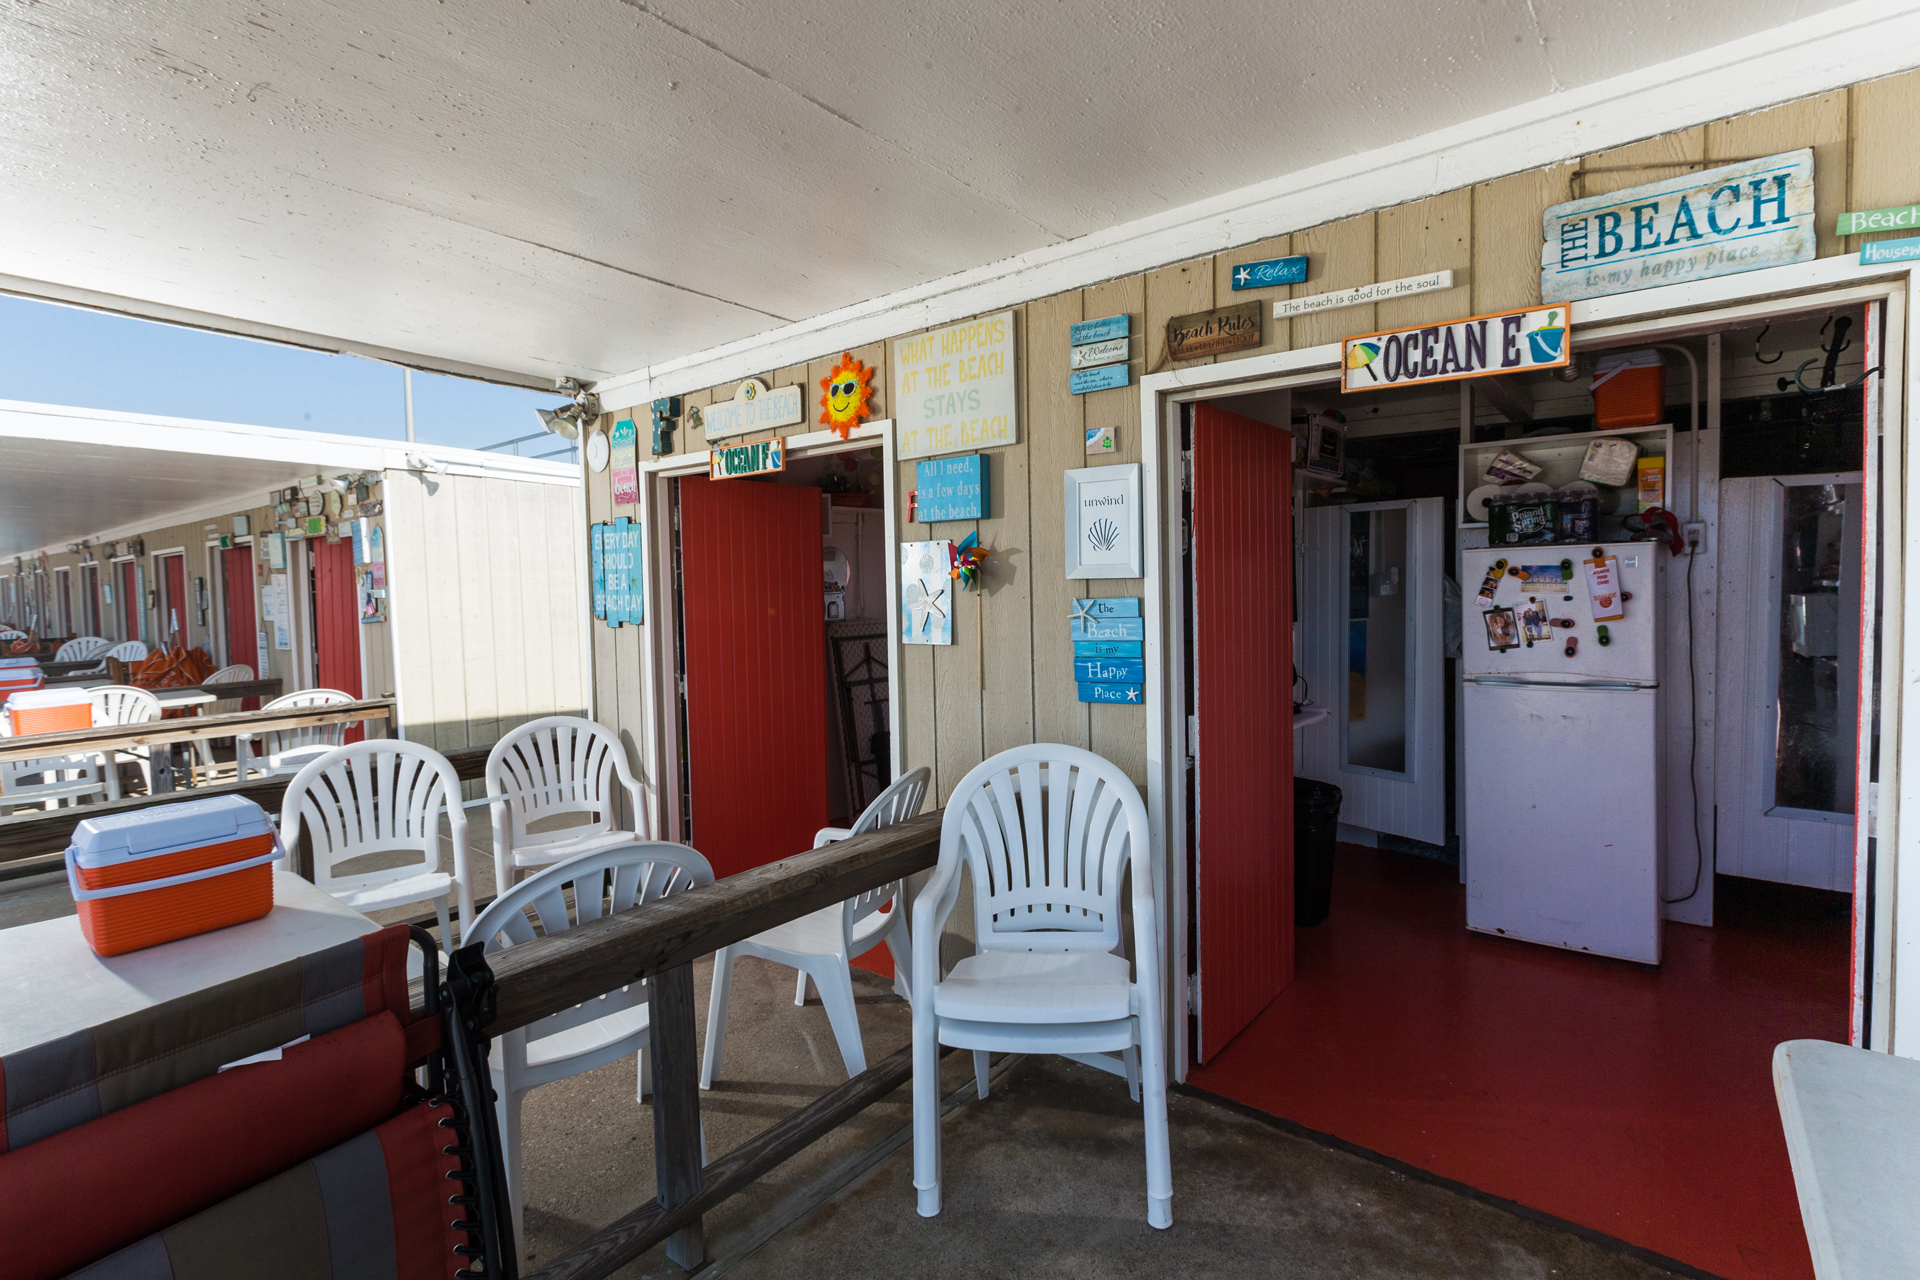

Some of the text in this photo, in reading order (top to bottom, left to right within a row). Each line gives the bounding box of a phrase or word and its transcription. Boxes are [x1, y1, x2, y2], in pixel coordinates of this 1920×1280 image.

[1593, 173, 1792, 259] BEACH
[1560, 217, 1588, 269] THE
[1254, 262, 1300, 281] Relax
[1585, 245, 1760, 287] is my happy place
[1282, 275, 1440, 314] The beach is good for the soul
[1173, 314, 1255, 347] Beach Rules
[899, 319, 1005, 367] WHAT HAPPENS
[1088, 344, 1124, 357] Welcome
[1383, 315, 1522, 382] OCEAN E
[902, 350, 1004, 395] AT THE BEACH
[706, 392, 798, 433] WELCOME TO THE BEACH
[923, 388, 981, 419] STAYS
[902, 414, 1007, 454] AT THE BEACH
[724, 444, 760, 475] OCEAN
[923, 462, 938, 477] All
[946, 457, 974, 475] need,
[918, 481, 980, 499] is a few days
[1084, 493, 1124, 507] unwind
[918, 503, 981, 521] at the beach.
[1511, 505, 1544, 523] Poland
[1513, 515, 1546, 533] Spring
[594, 530, 639, 550] EVERY DAY
[600, 552, 634, 570] SHOULD
[608, 573, 627, 590] BE A
[596, 594, 642, 612] BEACH DAY
[1098, 602, 1114, 613] the
[1087, 621, 1127, 639] Beach
[1094, 643, 1119, 656] is my
[1087, 662, 1128, 680] Happy
[1094, 687, 1122, 699] Place
